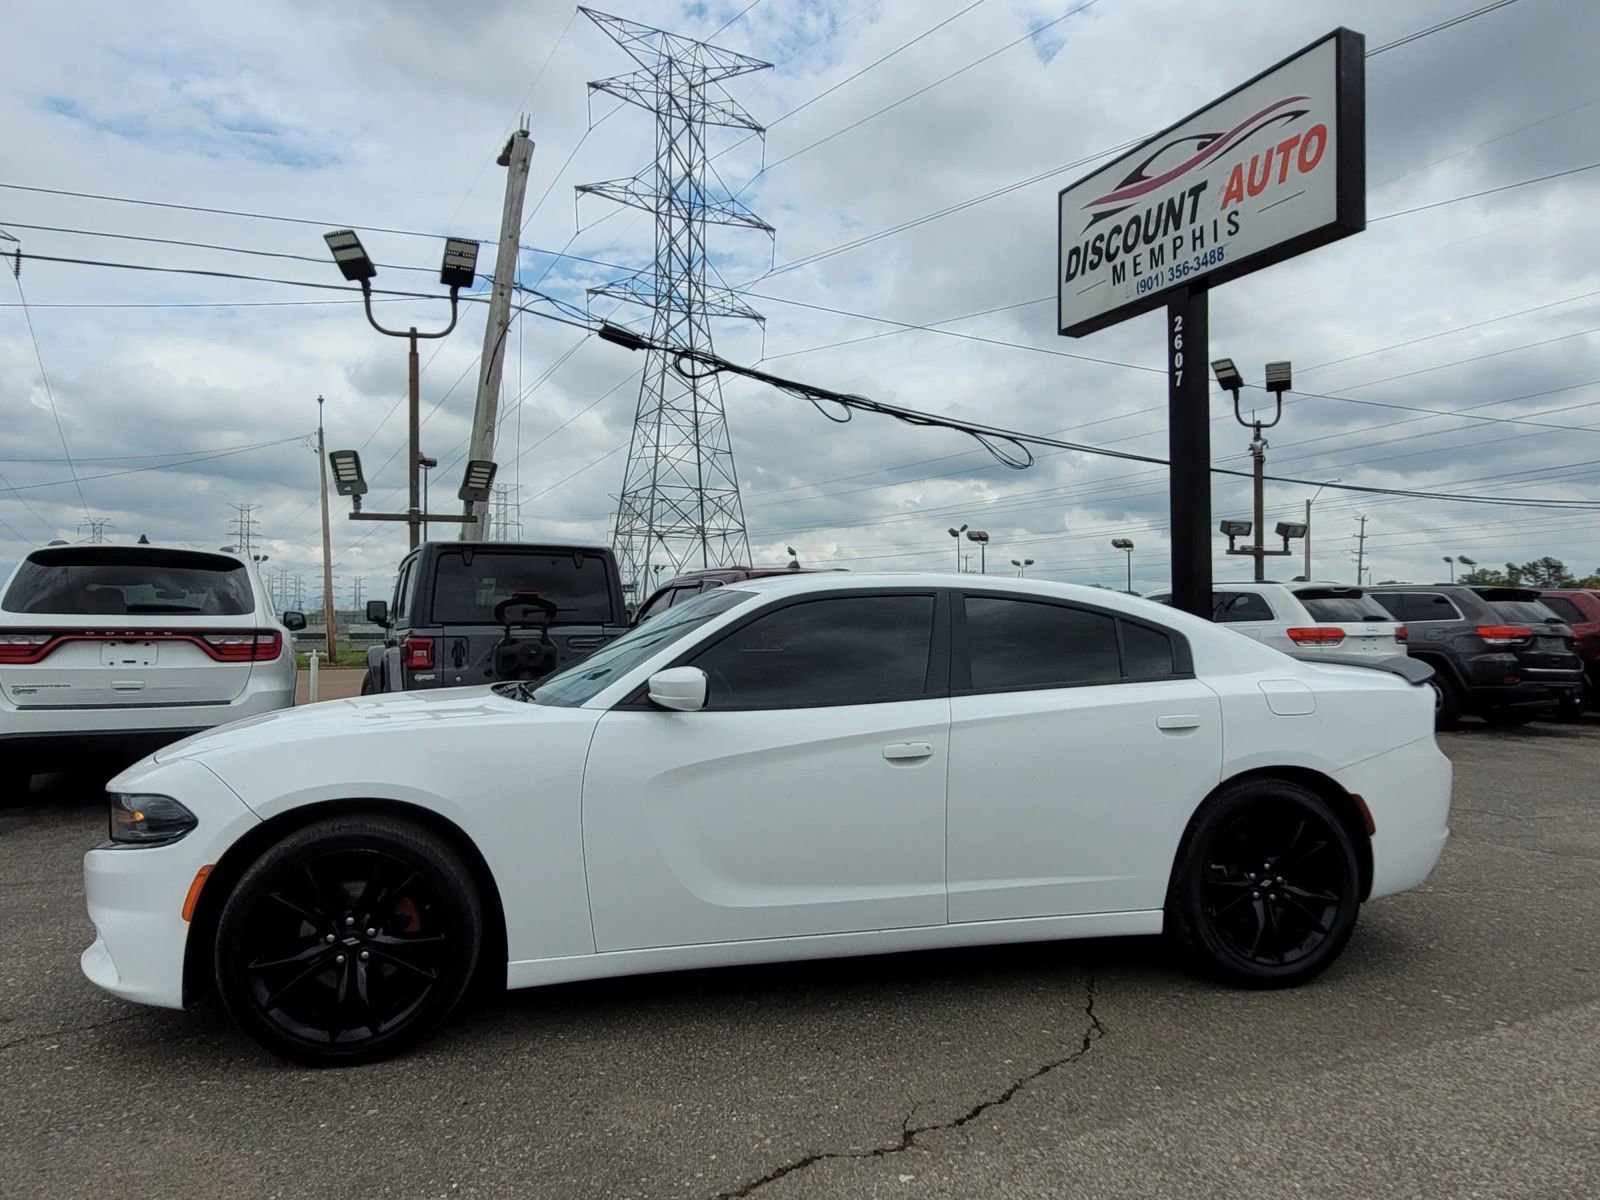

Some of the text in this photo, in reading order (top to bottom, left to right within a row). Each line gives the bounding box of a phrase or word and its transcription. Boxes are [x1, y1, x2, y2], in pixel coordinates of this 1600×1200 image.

[1065, 123, 1327, 283] DISCOUNT AUTO
[1112, 210, 1240, 286] MEMPHIS
[1136, 246, 1225, 295] (901) 356-3488
[1174, 315, 1183, 387] 2607
